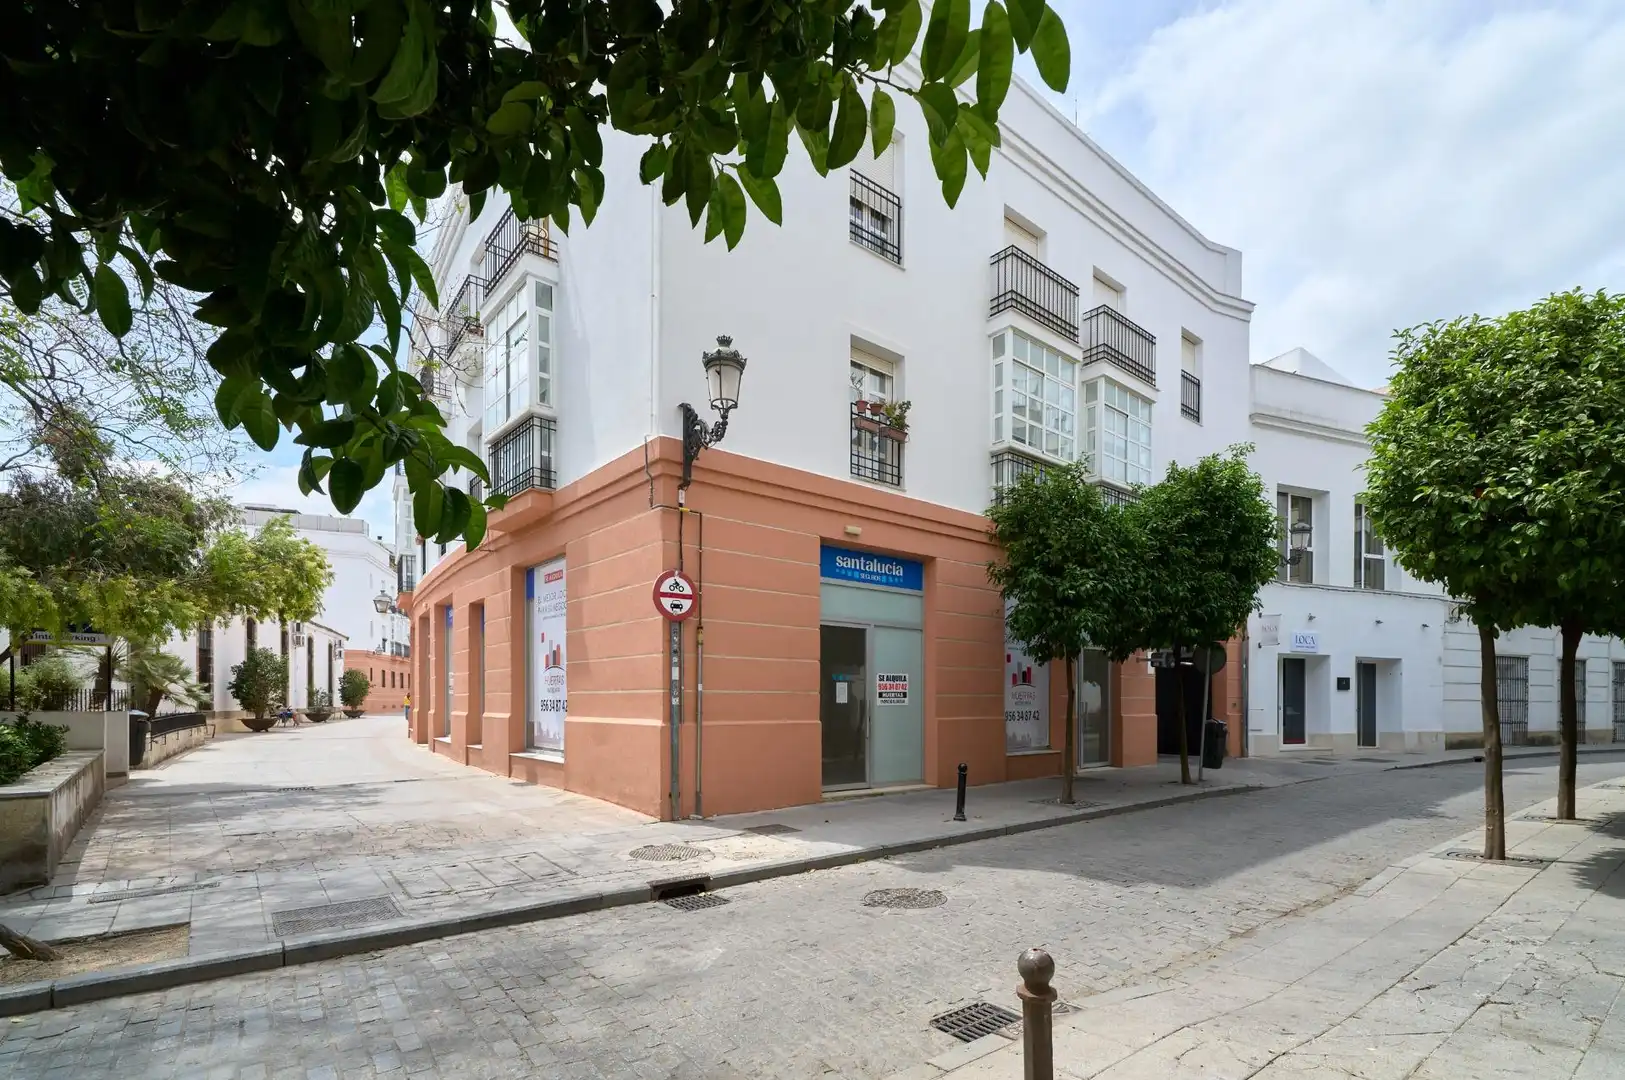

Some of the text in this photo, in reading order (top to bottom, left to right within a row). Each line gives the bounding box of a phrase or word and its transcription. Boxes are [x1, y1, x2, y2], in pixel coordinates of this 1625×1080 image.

[1296, 634, 1316, 645] LOCA
[878, 674, 907, 683] SE ALQUILA
[1005, 710, 1040, 722] 956 34 87 42
